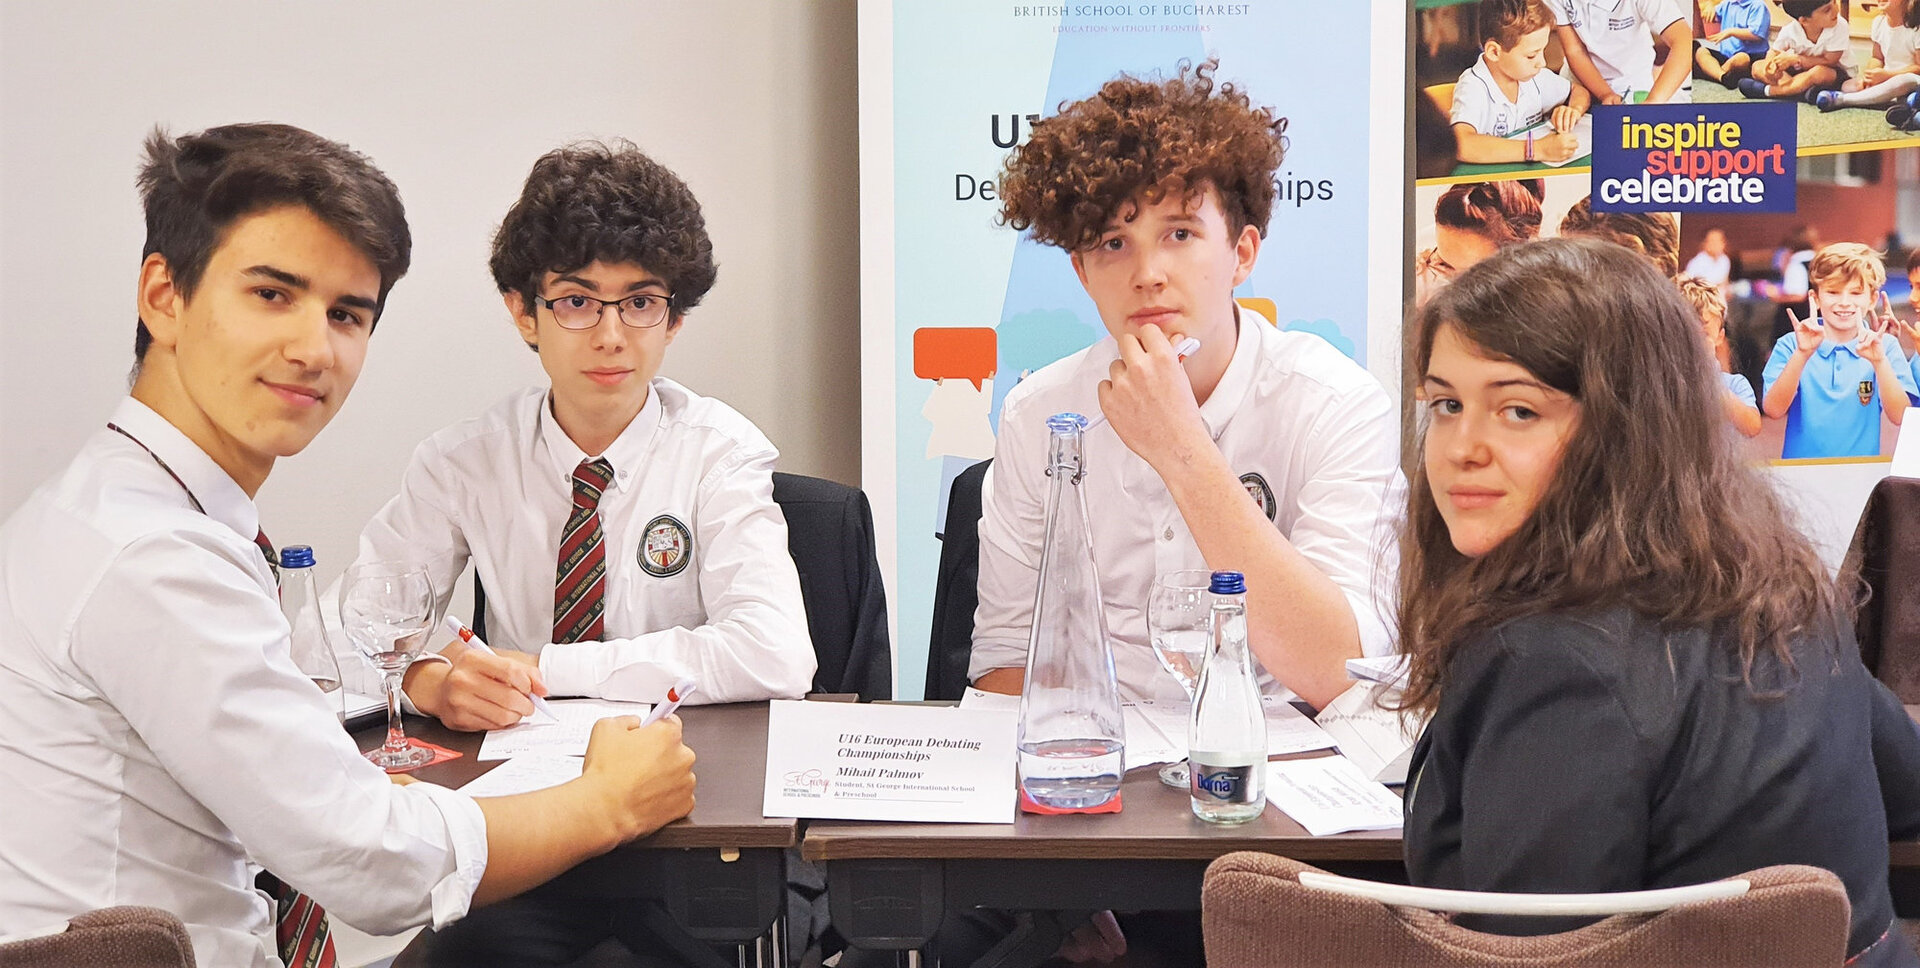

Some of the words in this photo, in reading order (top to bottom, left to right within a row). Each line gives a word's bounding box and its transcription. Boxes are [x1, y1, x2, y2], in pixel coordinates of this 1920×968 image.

[1014, 5, 1069, 17] BRITISH
[1075, 5, 1133, 17] SCHOOL
[1139, 5, 1158, 16] OF
[1163, 4, 1250, 16] BUCHAREST
[1052, 25, 1108, 34] EDUCATION
[1112, 24, 1157, 33] WITHOUT
[1160, 23, 1212, 33] FRONTIERS
[1622, 115, 1742, 156] inspire
[1646, 144, 1786, 182] support
[1600, 168, 1765, 205] celebrate
[838, 734, 861, 744] U16
[864, 734, 923, 748] European
[926, 737, 982, 751] Debating
[837, 748, 931, 762] Championships
[836, 767, 876, 778] Mihail
[878, 768, 924, 780] Palmov
[834, 781, 864, 789] Student,
[876, 783, 901, 791] George
[903, 783, 949, 792] International
[1197, 773, 1231, 792] Dorna
[842, 791, 877, 799] Preschool
